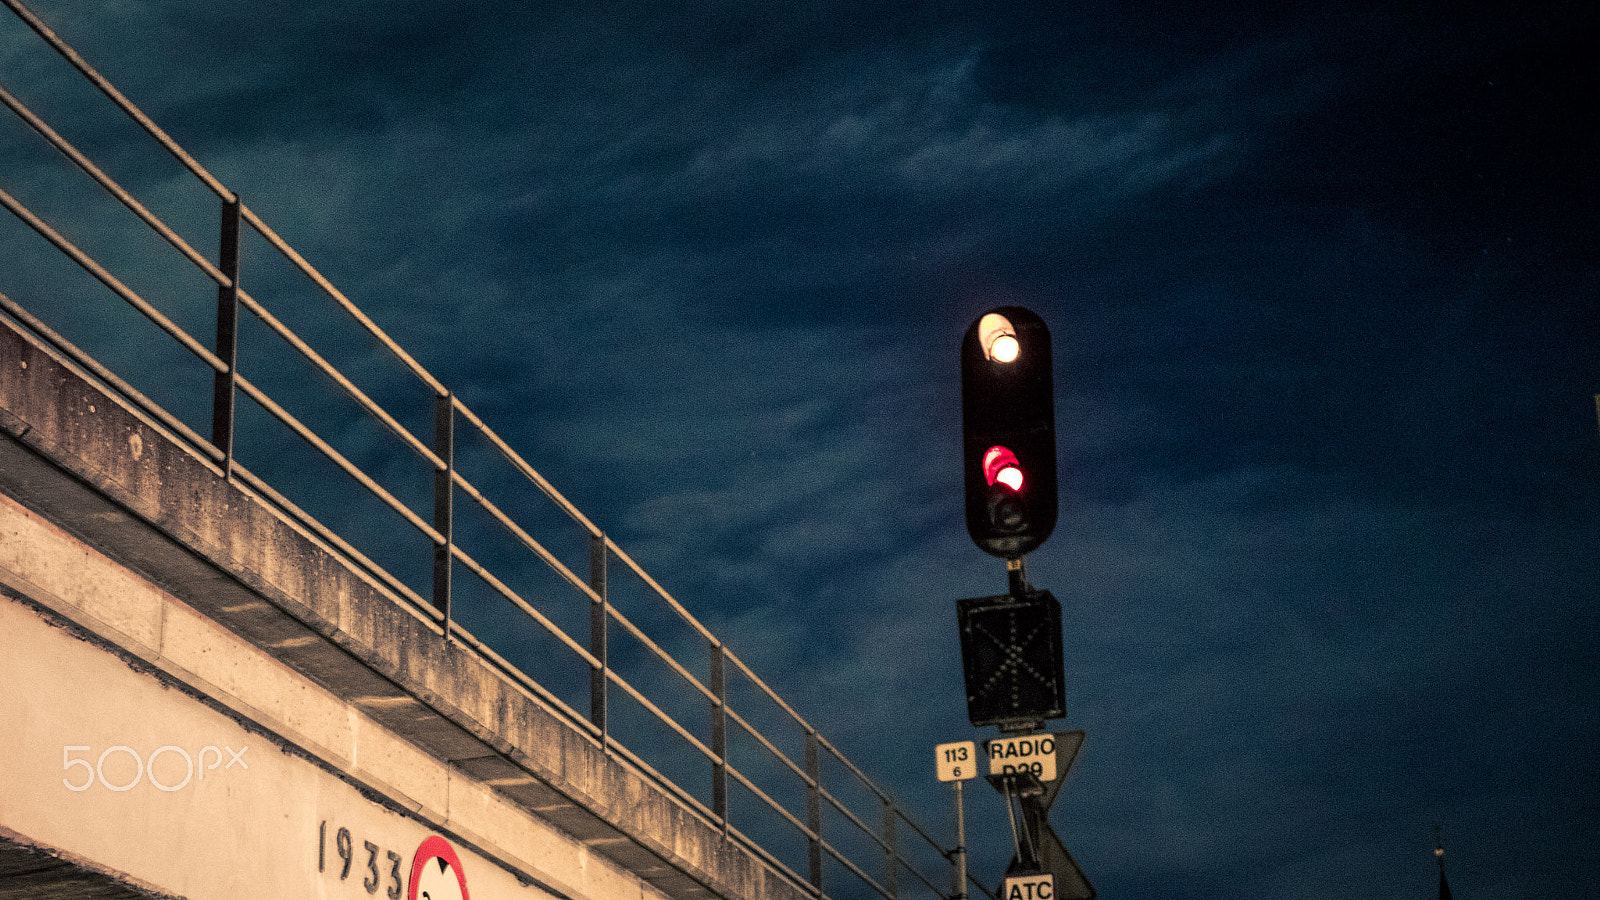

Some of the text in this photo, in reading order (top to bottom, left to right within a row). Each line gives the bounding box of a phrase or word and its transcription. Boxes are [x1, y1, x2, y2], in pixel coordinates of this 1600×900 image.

[945, 747, 968, 763] 113
[991, 738, 1055, 760] RADIO
[953, 767, 961, 777] 6
[319, 820, 403, 900] 1933
[1010, 882, 1052, 900] ATC
